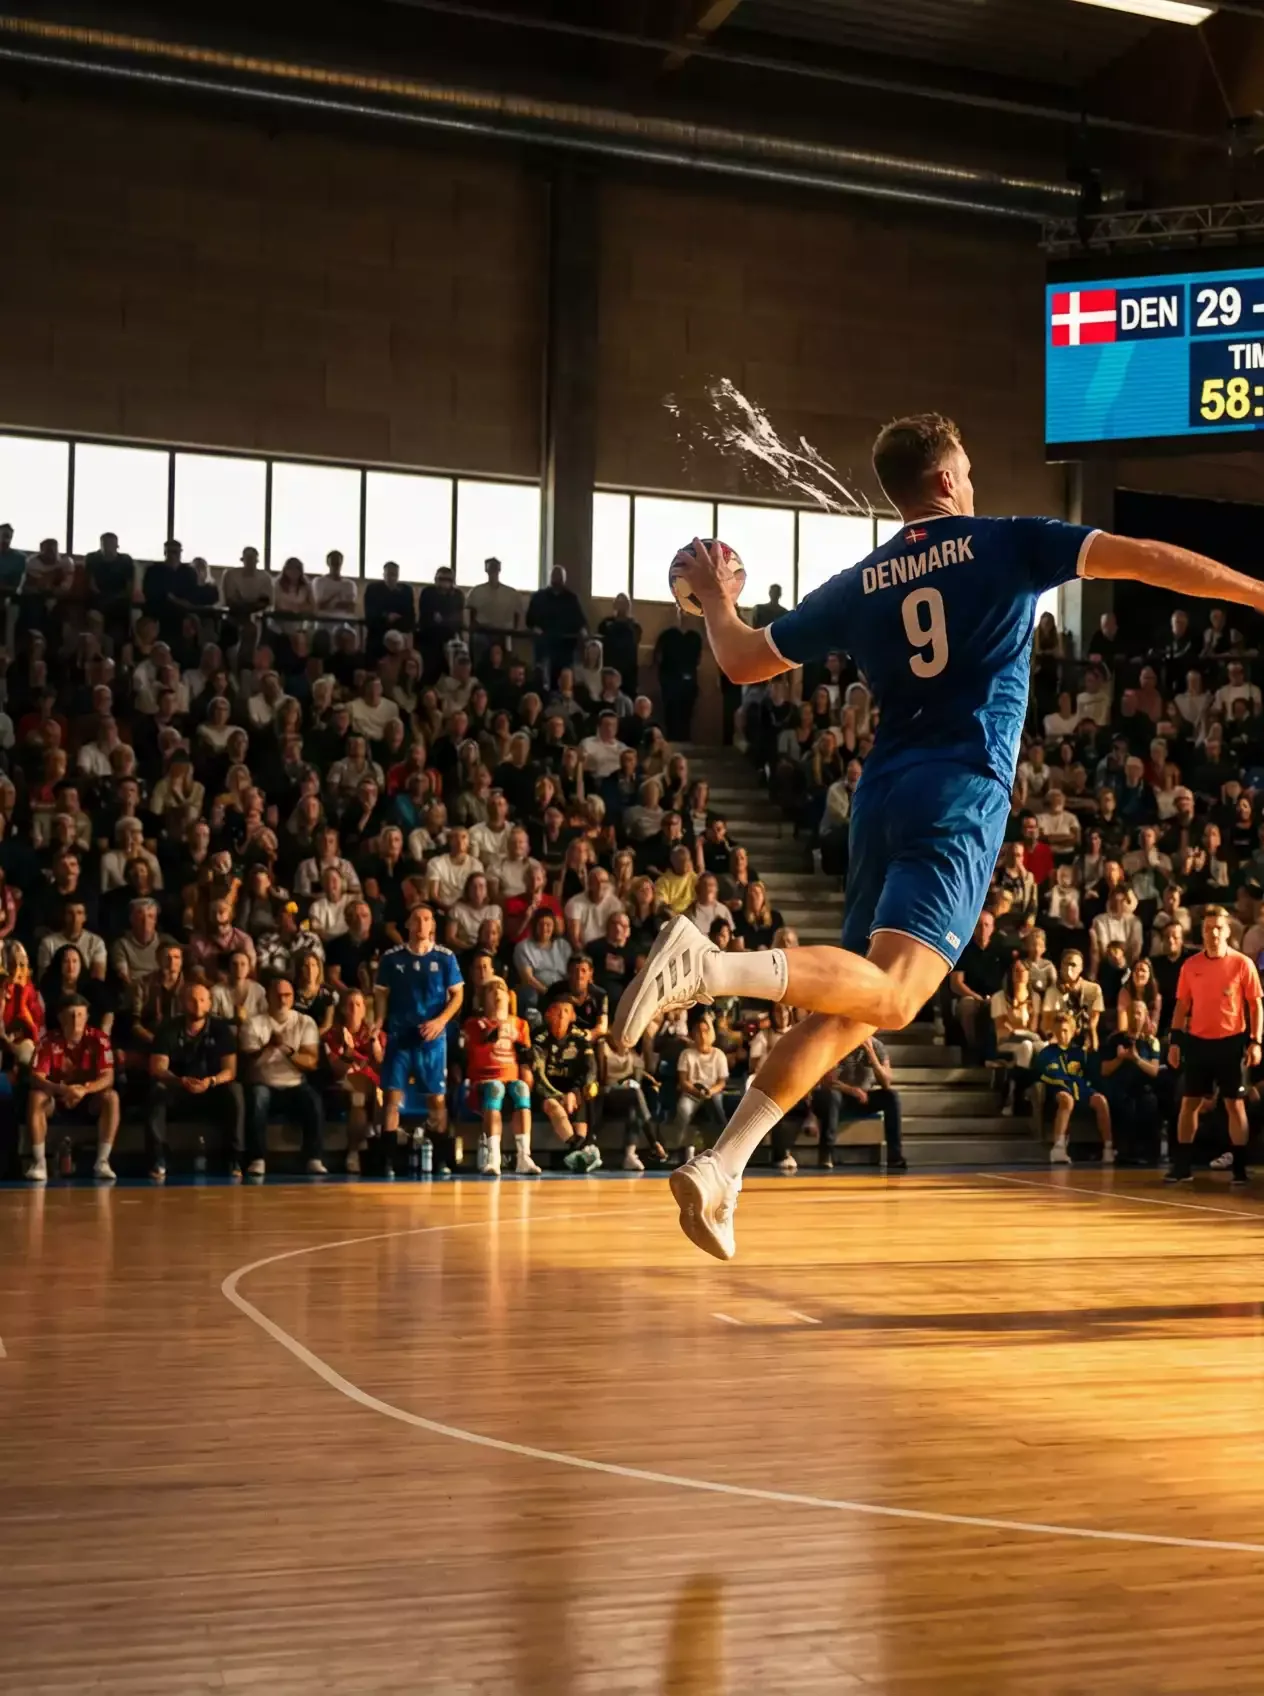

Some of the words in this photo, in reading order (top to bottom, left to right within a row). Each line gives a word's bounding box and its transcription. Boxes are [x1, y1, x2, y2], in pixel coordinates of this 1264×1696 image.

[1120, 295, 1178, 331] DEN
[1196, 287, 1242, 328] 29
[862, 534, 976, 595] DENMARK
[901, 587, 950, 679] 9
